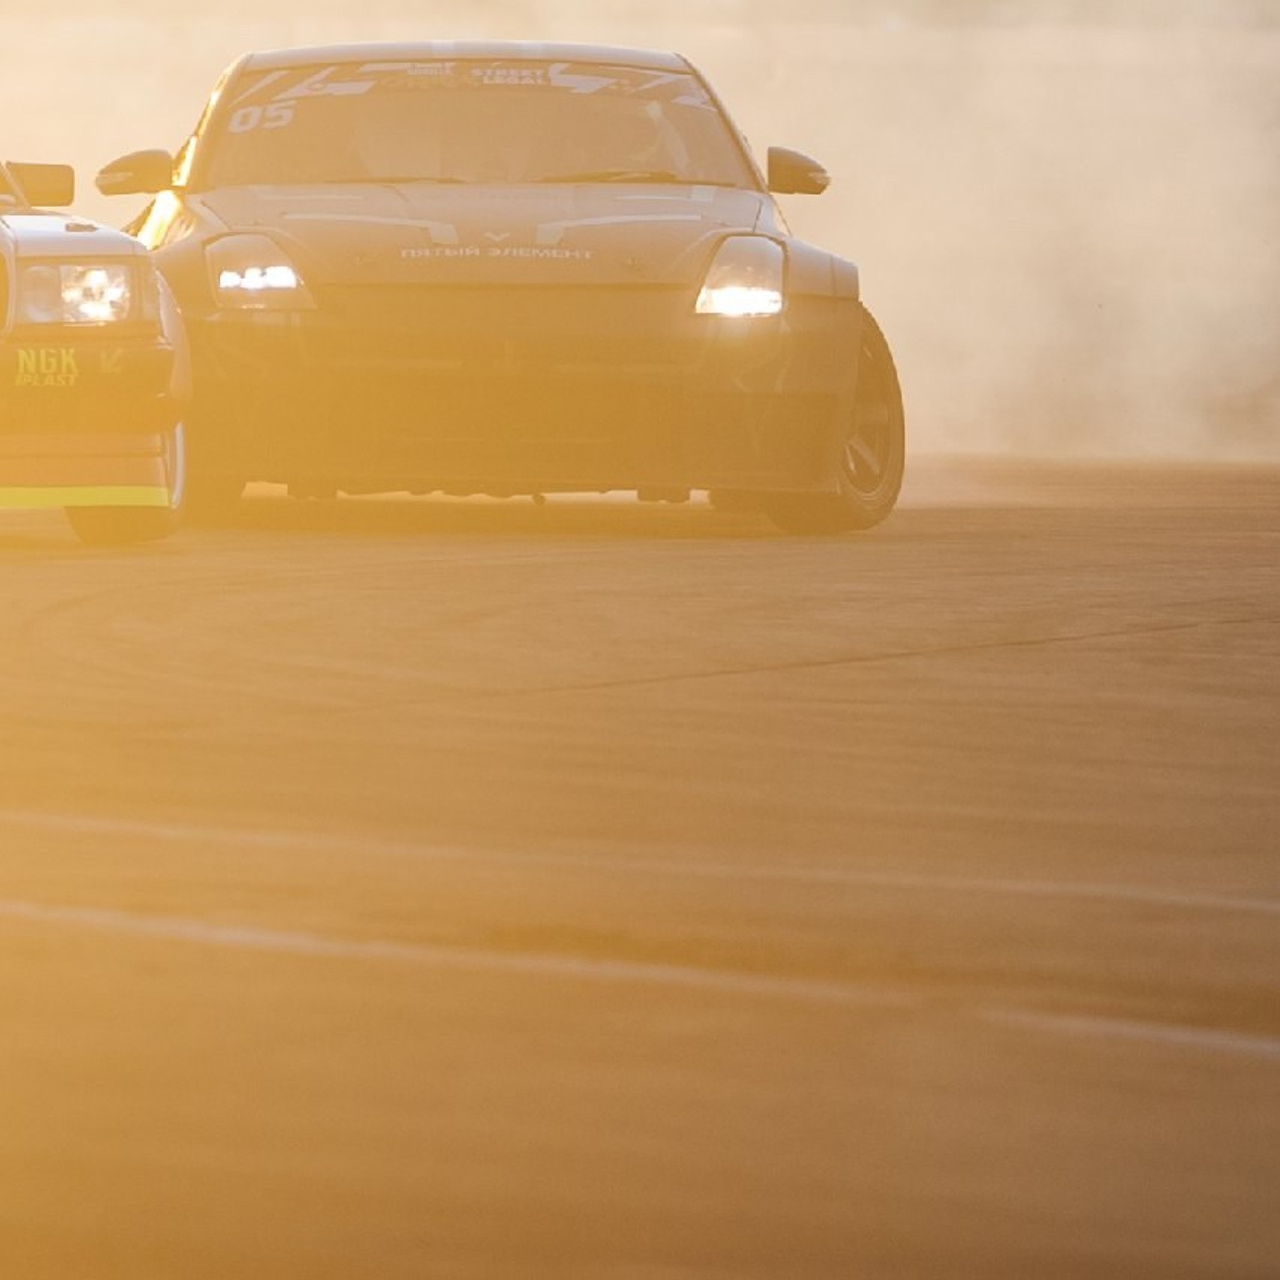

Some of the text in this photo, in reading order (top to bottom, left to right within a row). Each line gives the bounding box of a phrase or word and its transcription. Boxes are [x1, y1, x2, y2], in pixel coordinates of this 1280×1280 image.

[469, 67, 545, 76] STREET
[482, 75, 549, 84] LEGAL
[227, 100, 297, 133] 05
[399, 246, 595, 260] ПЯТЫЙ ЭЛЕМЕНТ
[15, 347, 80, 374] NGK
